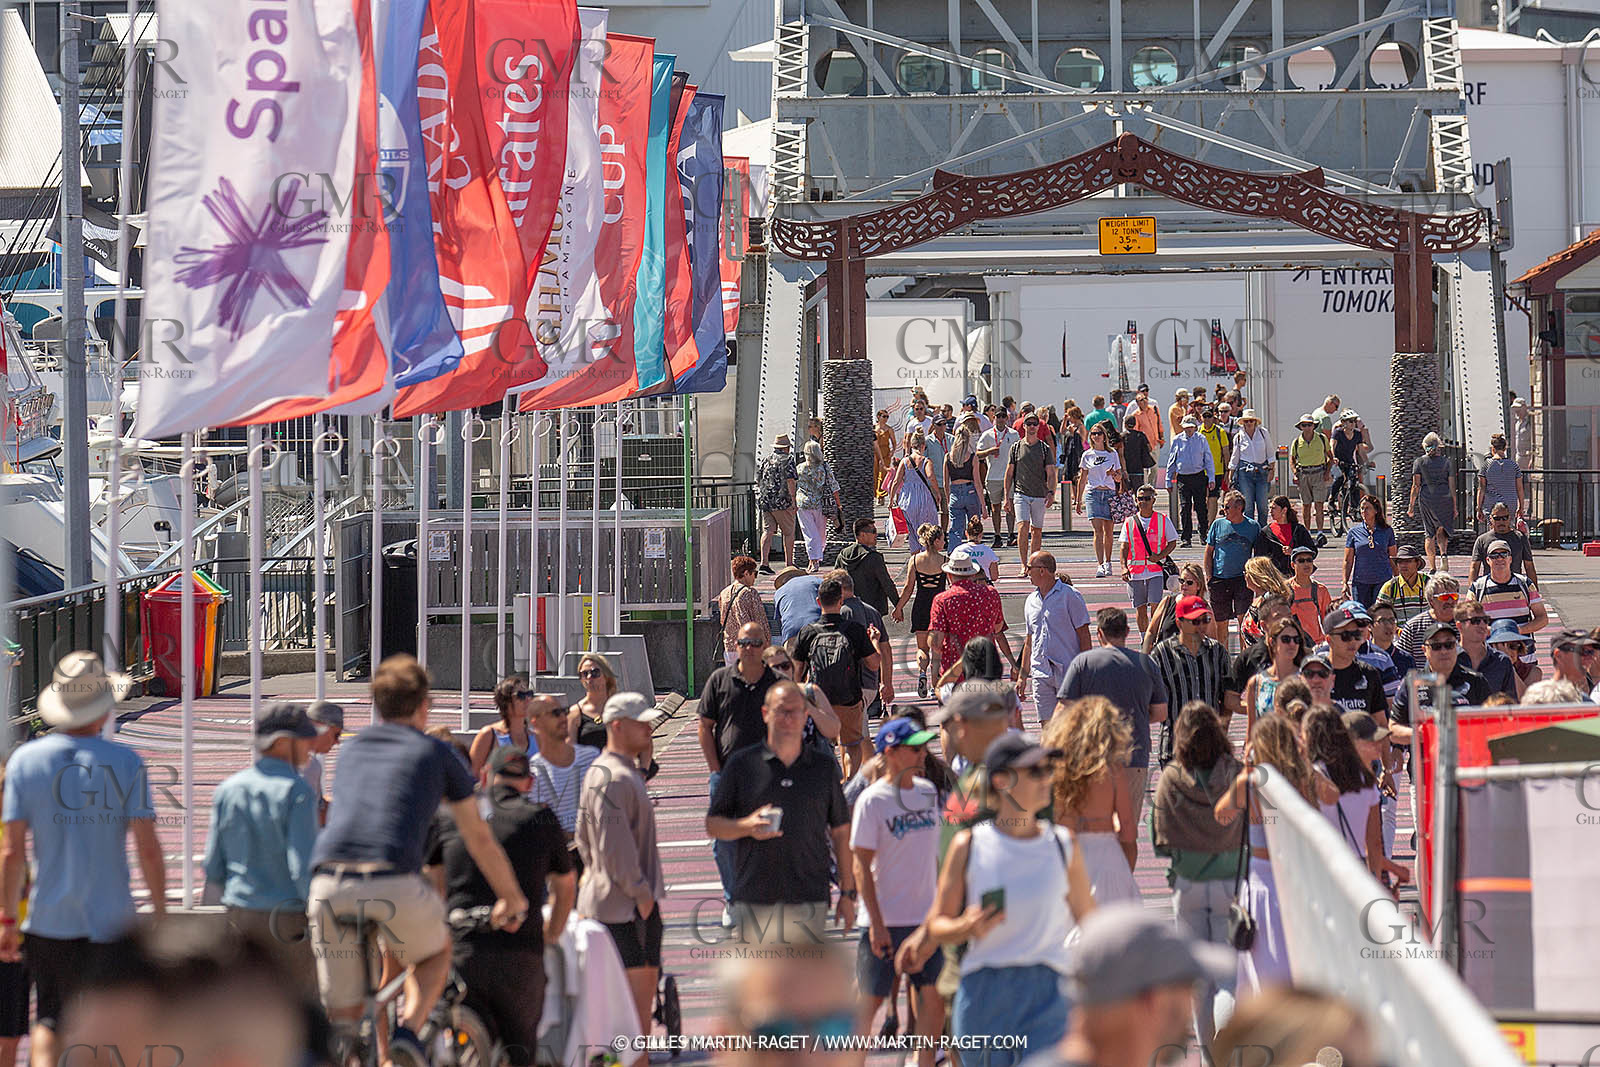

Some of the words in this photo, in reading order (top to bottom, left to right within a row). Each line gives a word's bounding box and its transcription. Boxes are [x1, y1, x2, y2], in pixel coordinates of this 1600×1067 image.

[226, 0, 300, 143] Spa
[599, 124, 625, 224] CUP
[562, 169, 576, 314] CHAMPAGNE
[1322, 290, 1395, 313] TOMOK
